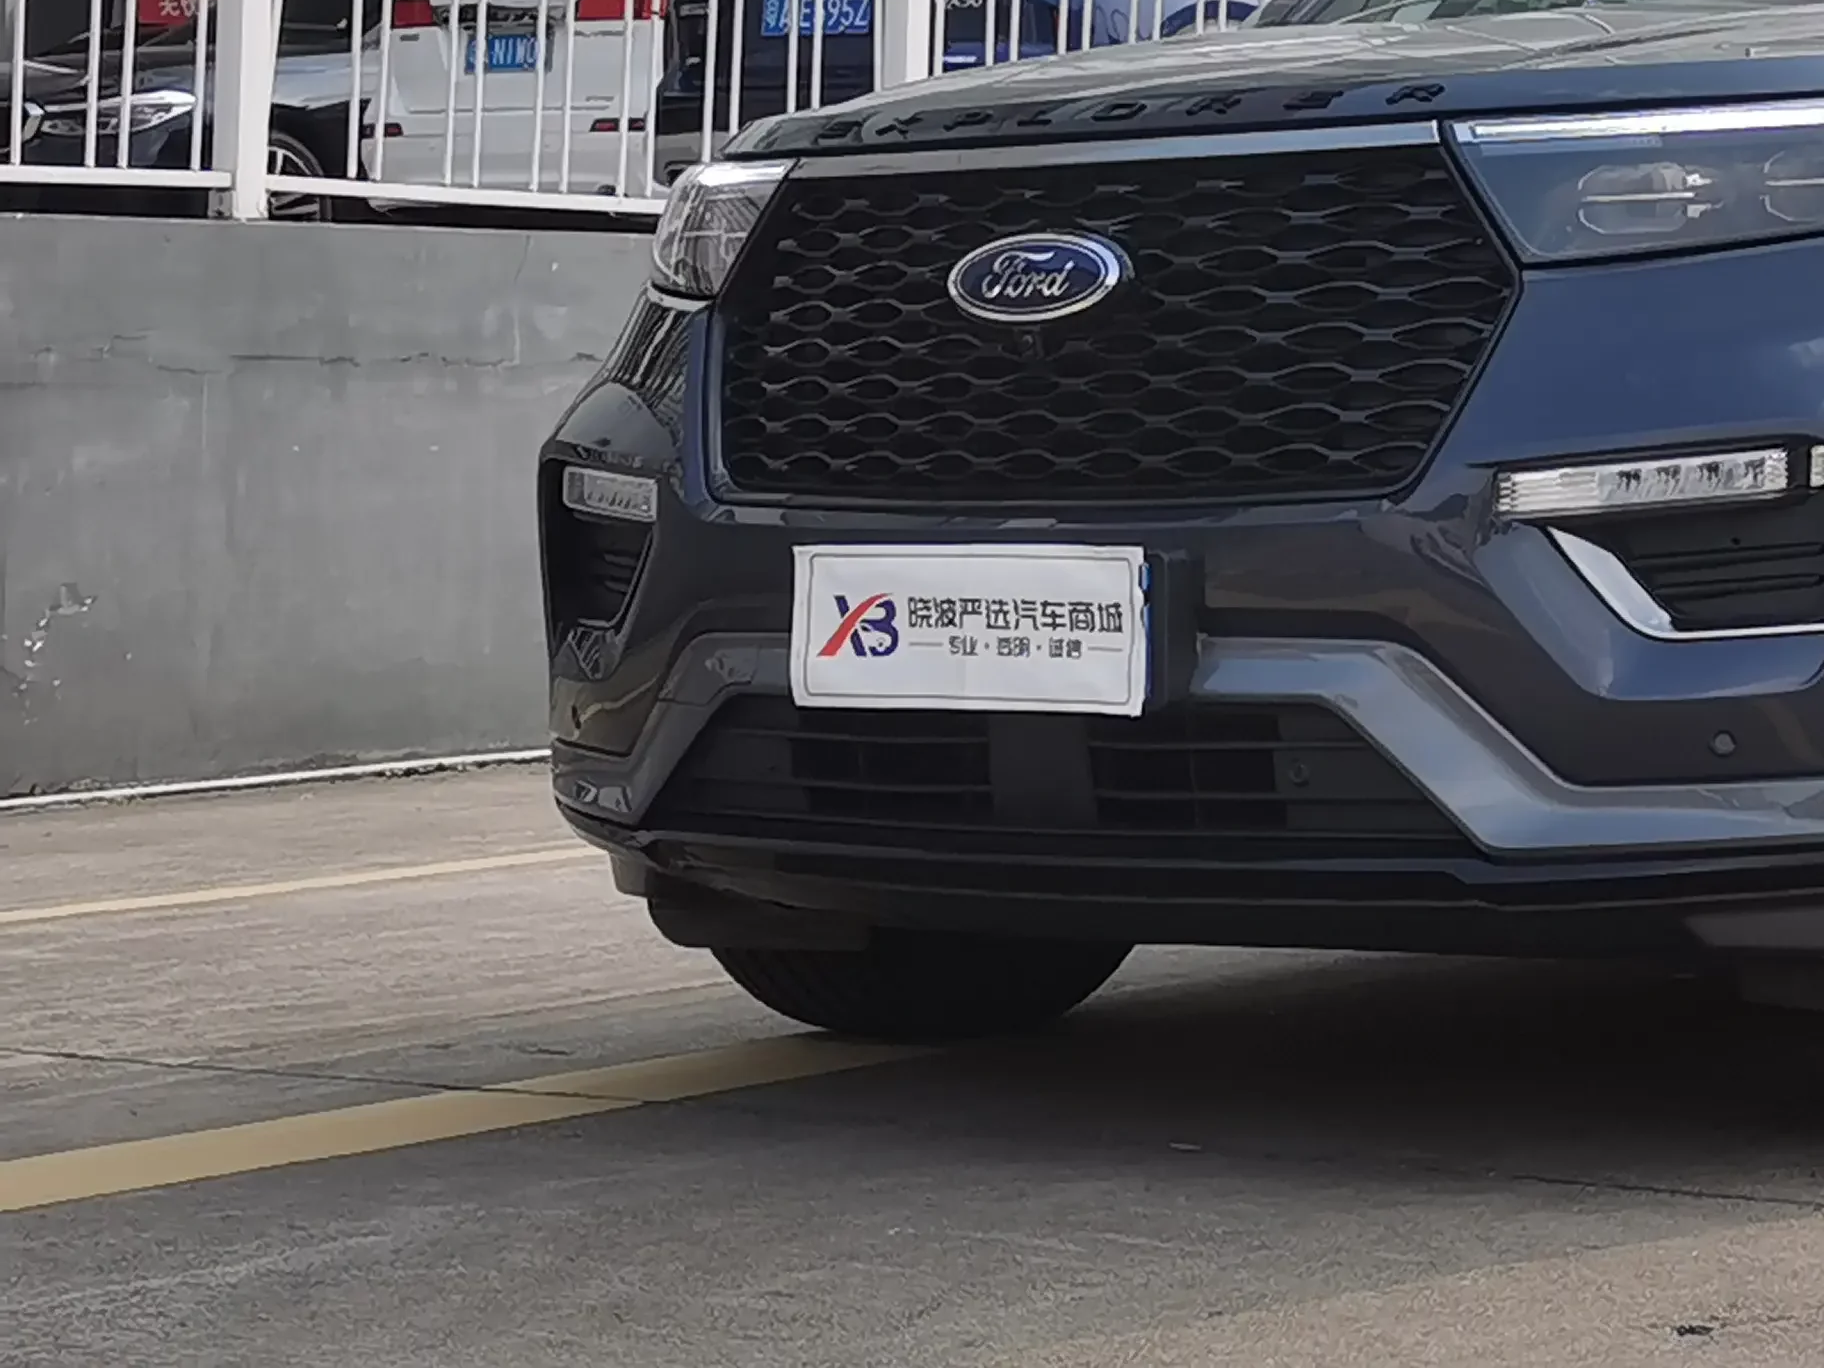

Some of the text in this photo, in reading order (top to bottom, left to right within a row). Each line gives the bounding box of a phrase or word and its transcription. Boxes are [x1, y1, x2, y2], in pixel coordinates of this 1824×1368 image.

[982, 251, 1075, 299] Ford
[907, 596, 1124, 633] 晓波严选汽车商城
